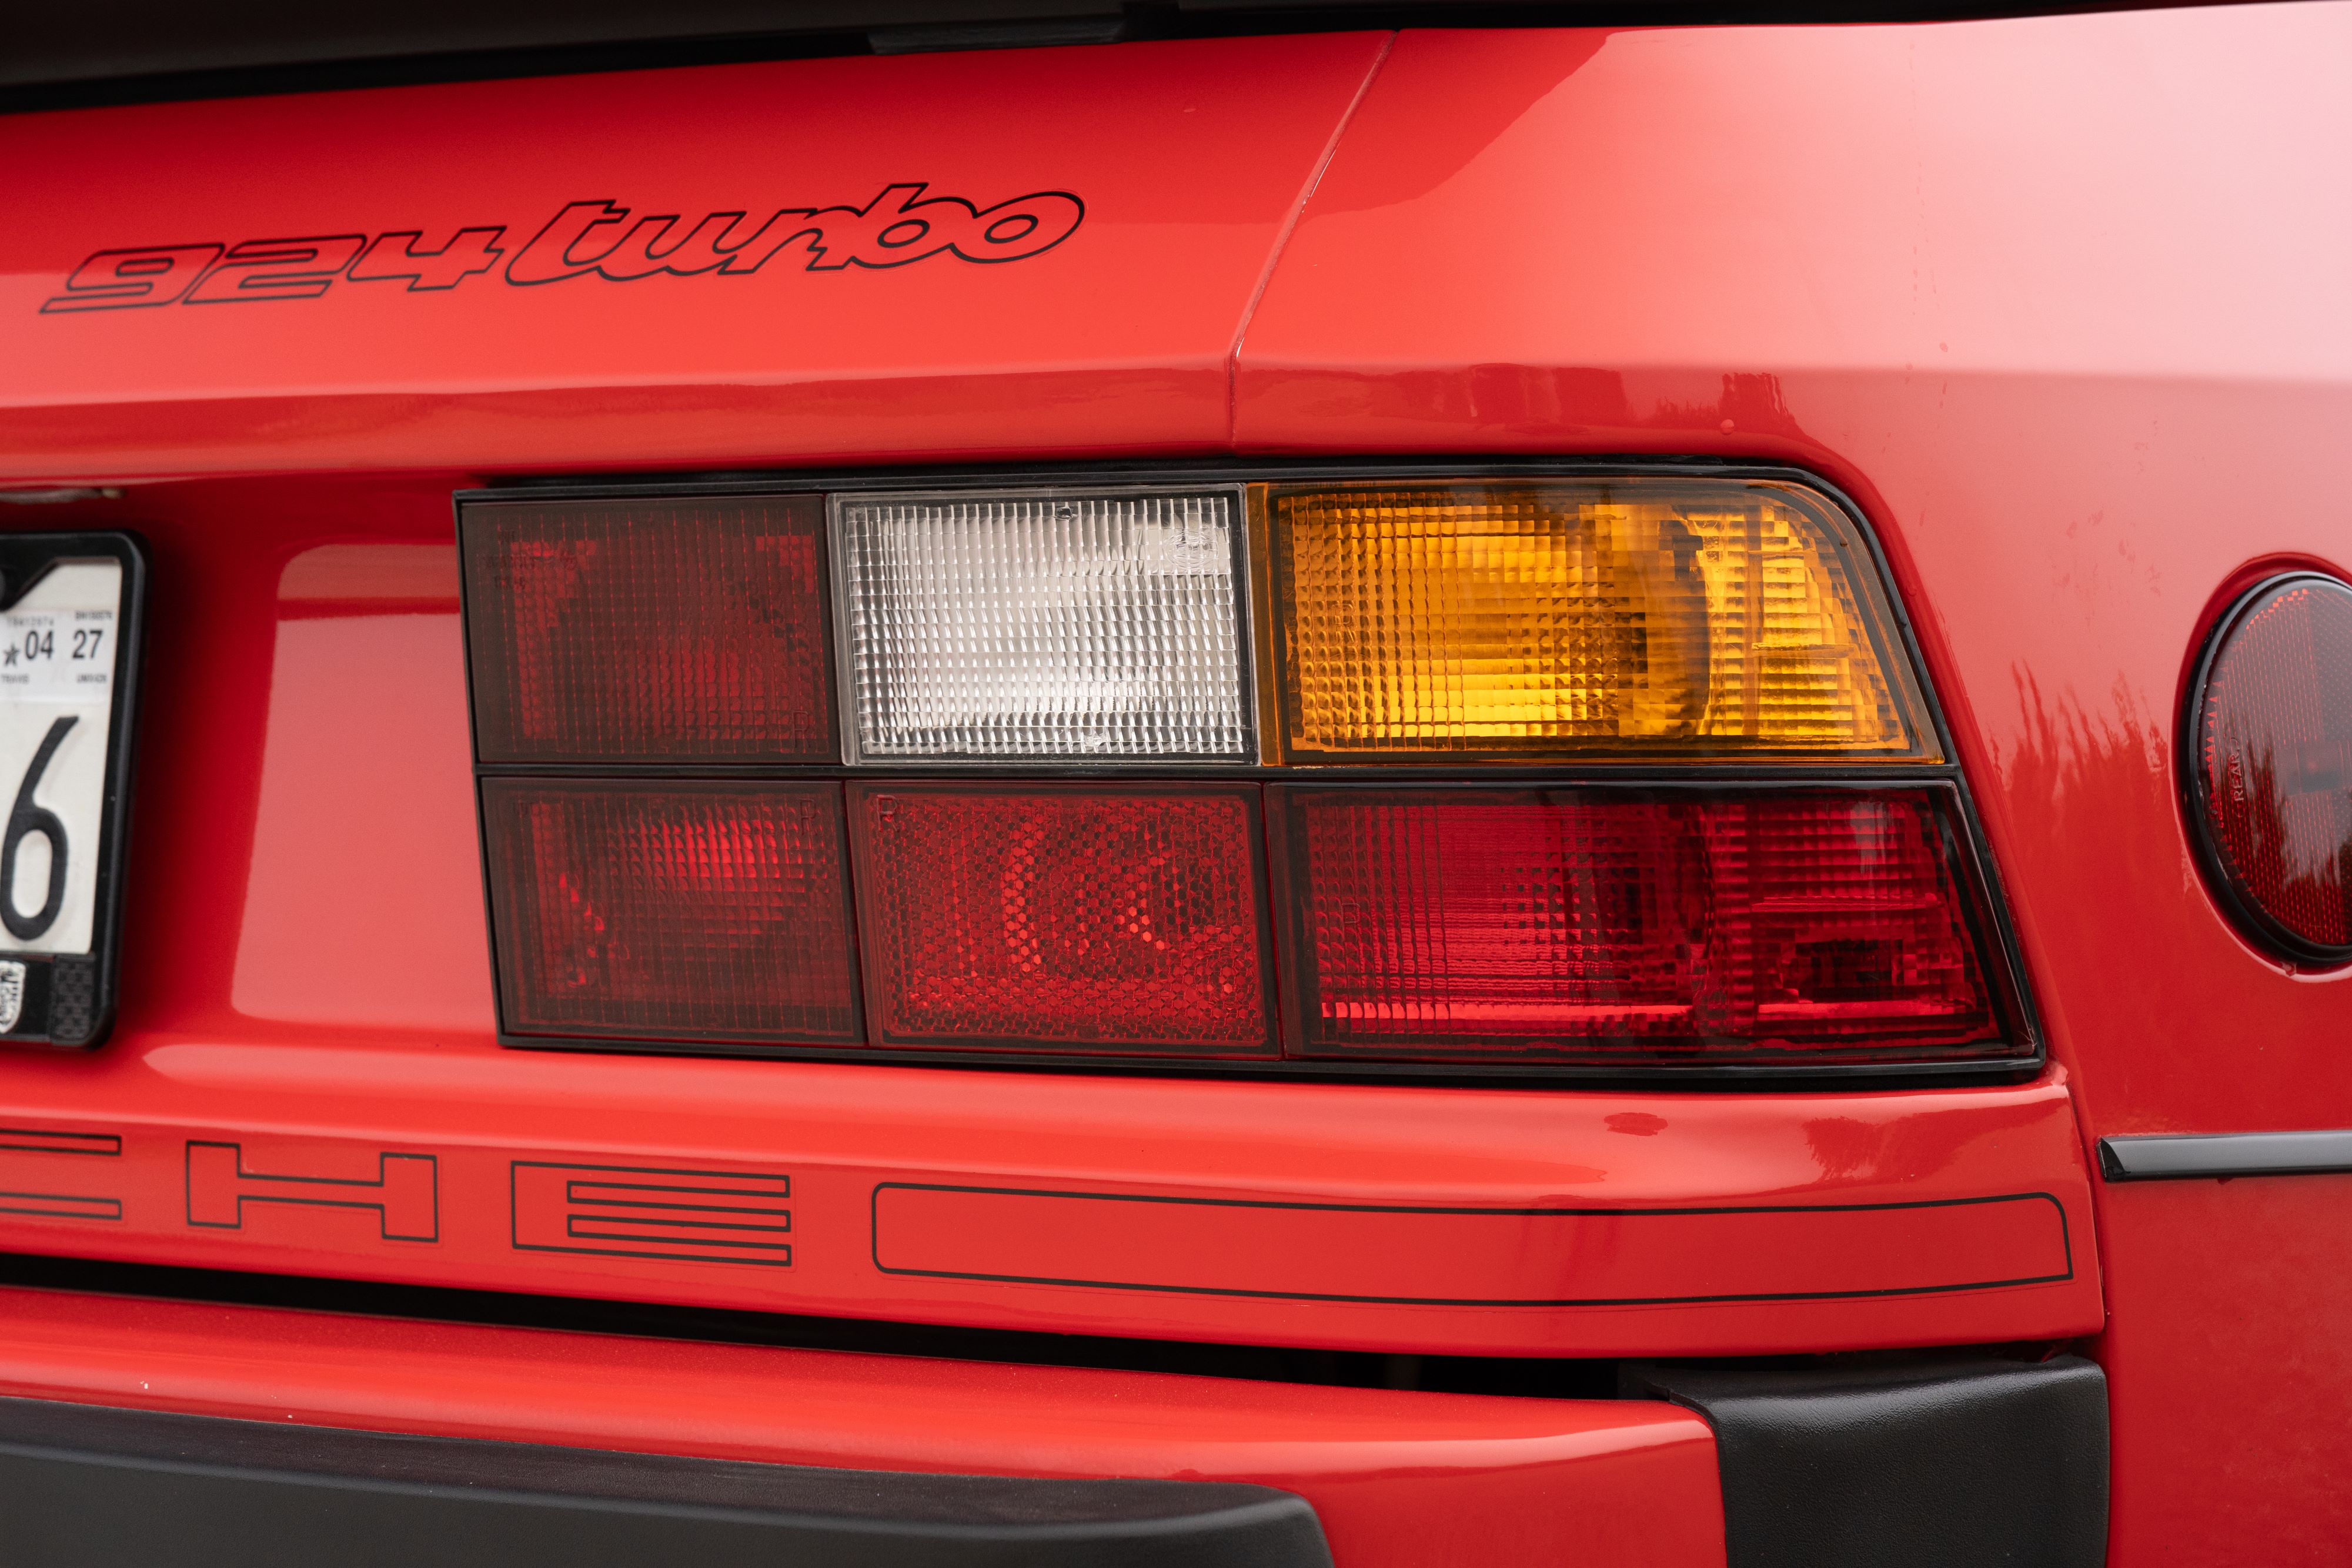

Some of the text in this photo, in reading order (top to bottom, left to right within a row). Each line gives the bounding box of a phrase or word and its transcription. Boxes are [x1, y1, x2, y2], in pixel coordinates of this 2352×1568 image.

[25, 628, 103, 660] 04 27
[0, 716, 79, 941] 6
